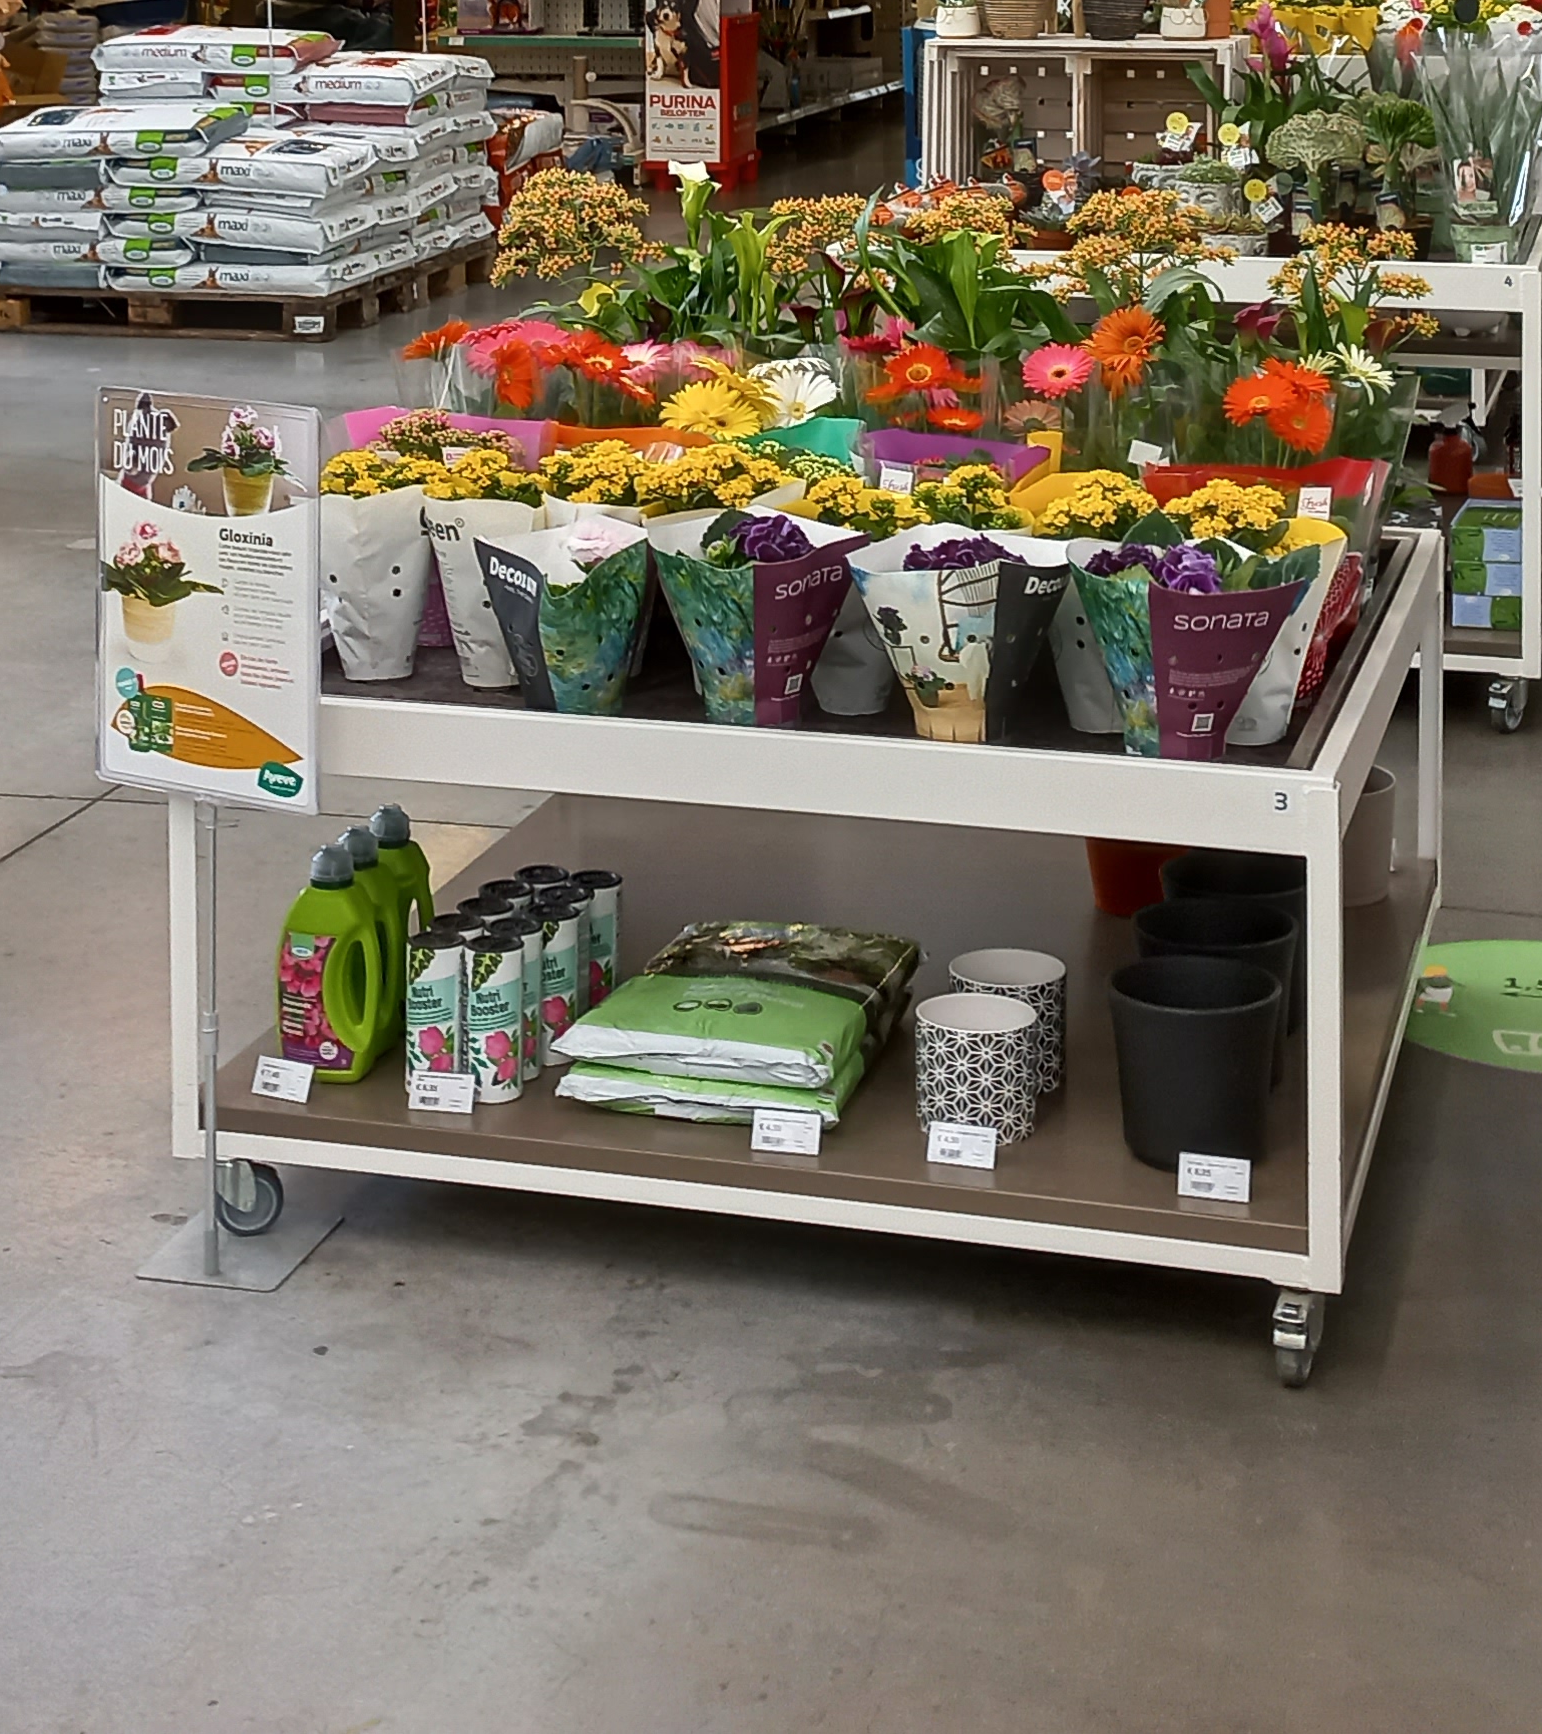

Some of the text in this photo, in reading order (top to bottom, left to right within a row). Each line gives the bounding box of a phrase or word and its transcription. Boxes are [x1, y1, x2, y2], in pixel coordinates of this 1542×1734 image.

[141, 46, 187, 58] medium
[315, 78, 362, 91] medium
[649, 94, 717, 110] PURINA
[660, 109, 706, 118] BELOFTEN
[63, 136, 93, 148] maxi
[220, 164, 252, 177] maxi
[57, 190, 86, 202] maxi
[218, 217, 249, 231] maxi
[53, 244, 82, 255] maxi
[219, 269, 250, 282] maxi
[1504, 276, 1513, 287] 4
[113, 408, 169, 441] PLANTE
[113, 441, 174, 474] DU MOIS
[218, 527, 274, 547] Gloxinia
[489, 556, 537, 597] Deco
[1273, 791, 1288, 811] 3
[411, 985, 434, 998] Nutri
[476, 989, 501, 1003] Nutri
[471, 1000, 510, 1017] Booster
